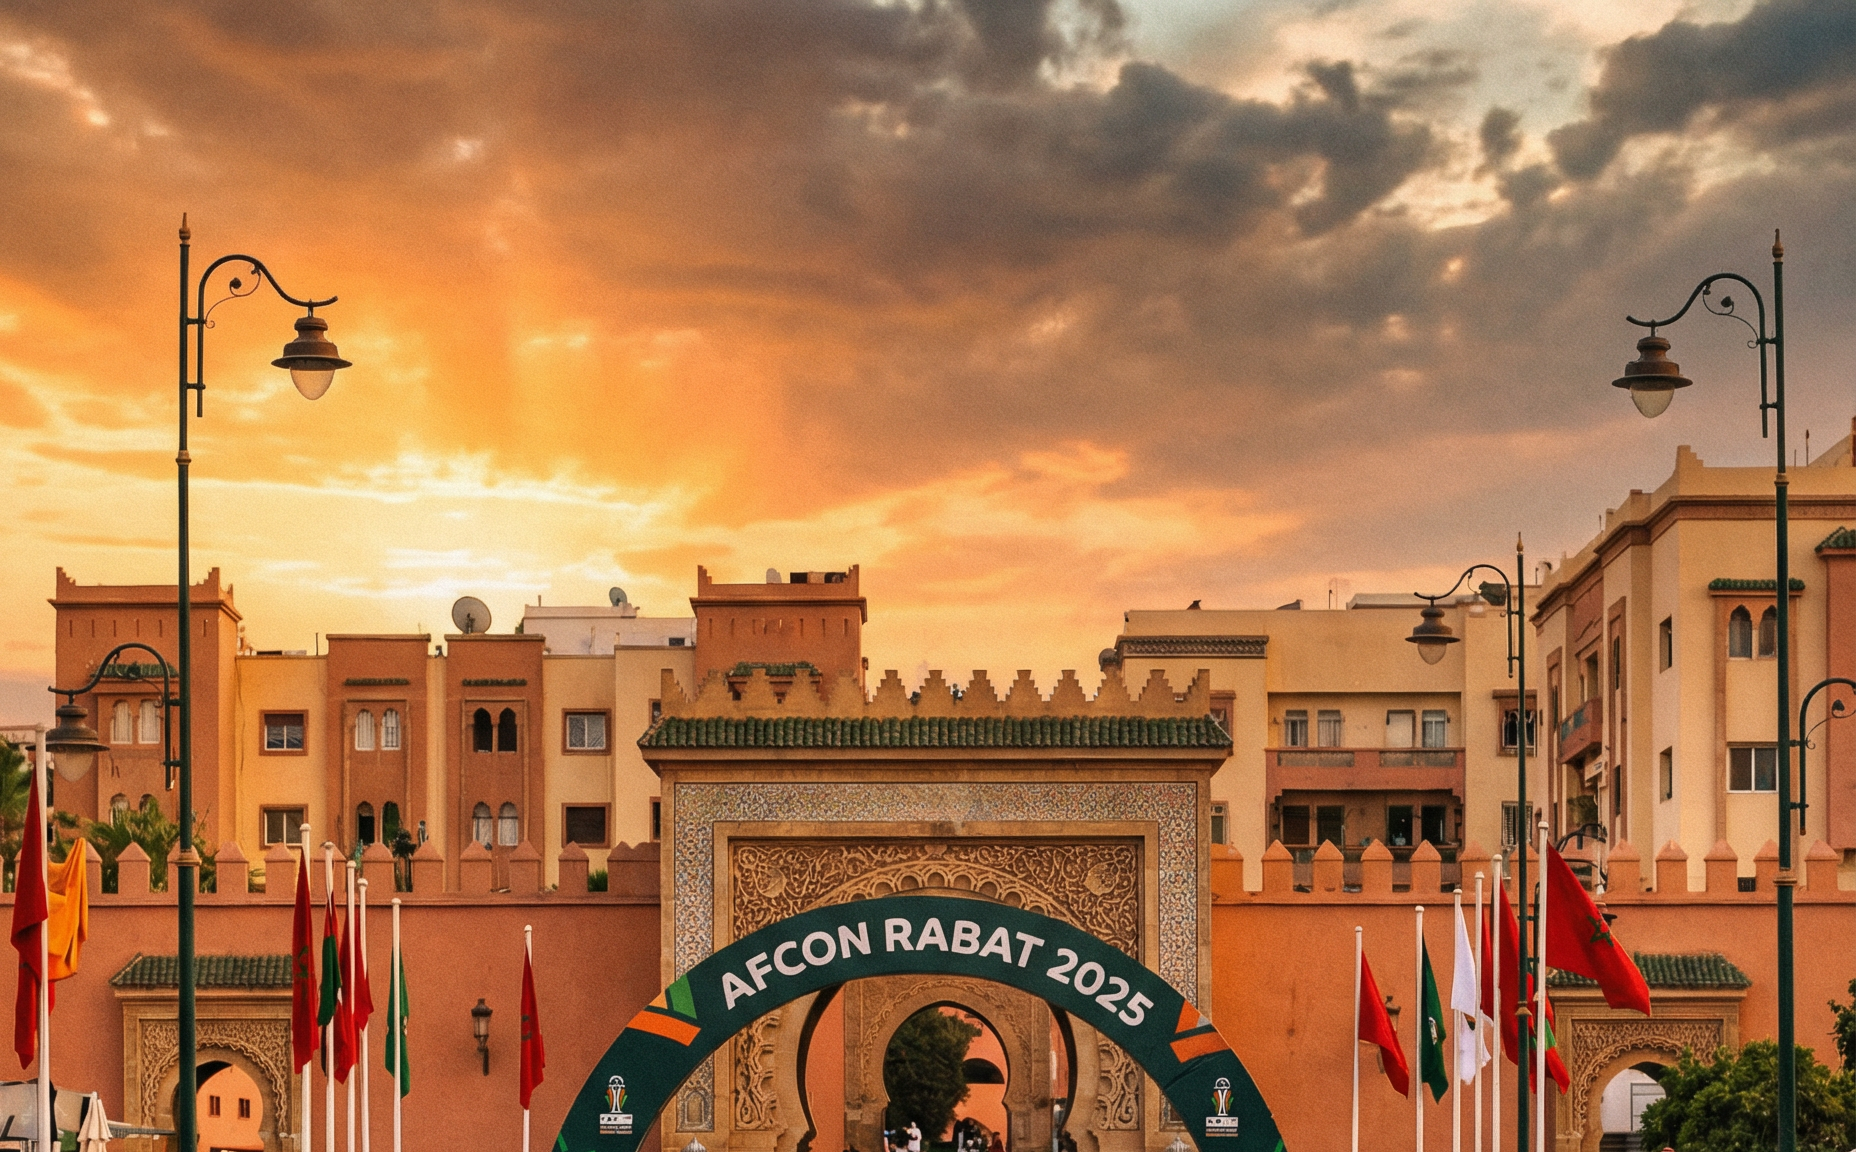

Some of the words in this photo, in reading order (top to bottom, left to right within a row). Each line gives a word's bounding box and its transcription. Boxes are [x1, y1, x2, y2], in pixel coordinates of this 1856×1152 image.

[722, 920, 871, 1010] AFCON
[885, 917, 1045, 968] RABAT
[1047, 948, 1154, 1026] 2025
